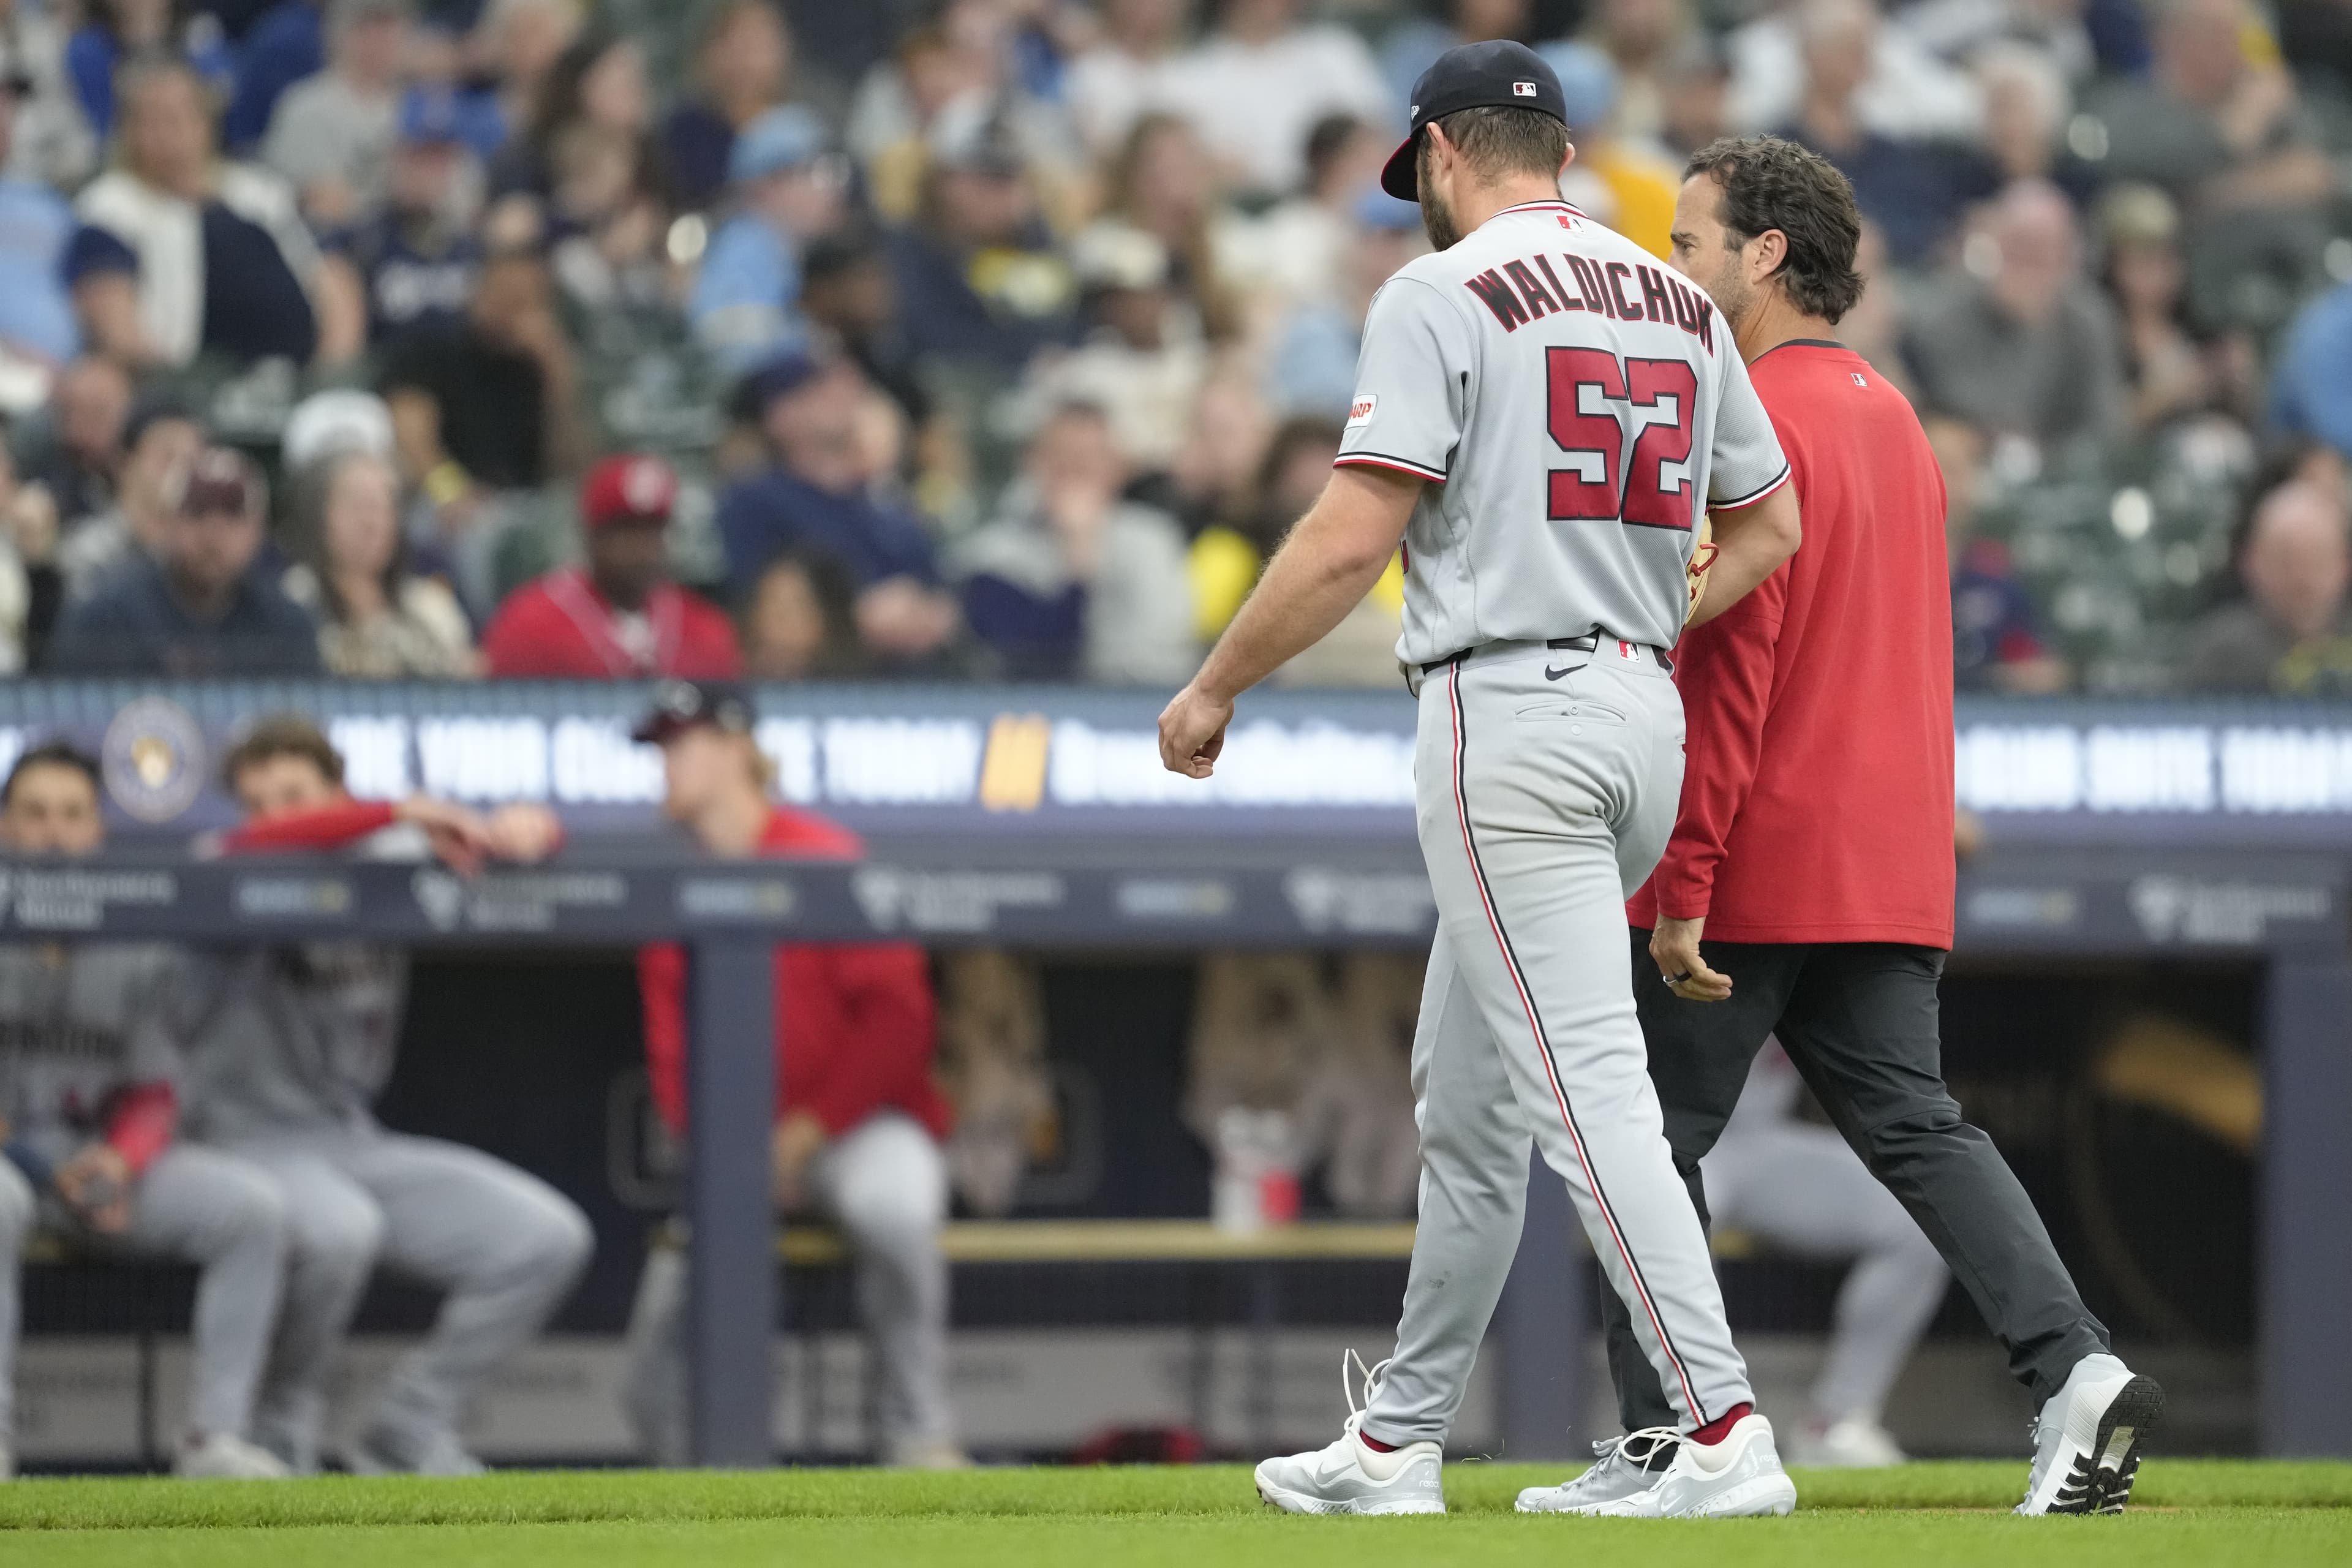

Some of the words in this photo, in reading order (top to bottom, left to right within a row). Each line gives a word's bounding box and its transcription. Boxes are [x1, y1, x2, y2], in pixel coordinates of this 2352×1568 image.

[1464, 254, 1714, 358] WALDICHUK
[1349, 402, 1372, 420] ARP
[1545, 346, 1698, 532] 52
